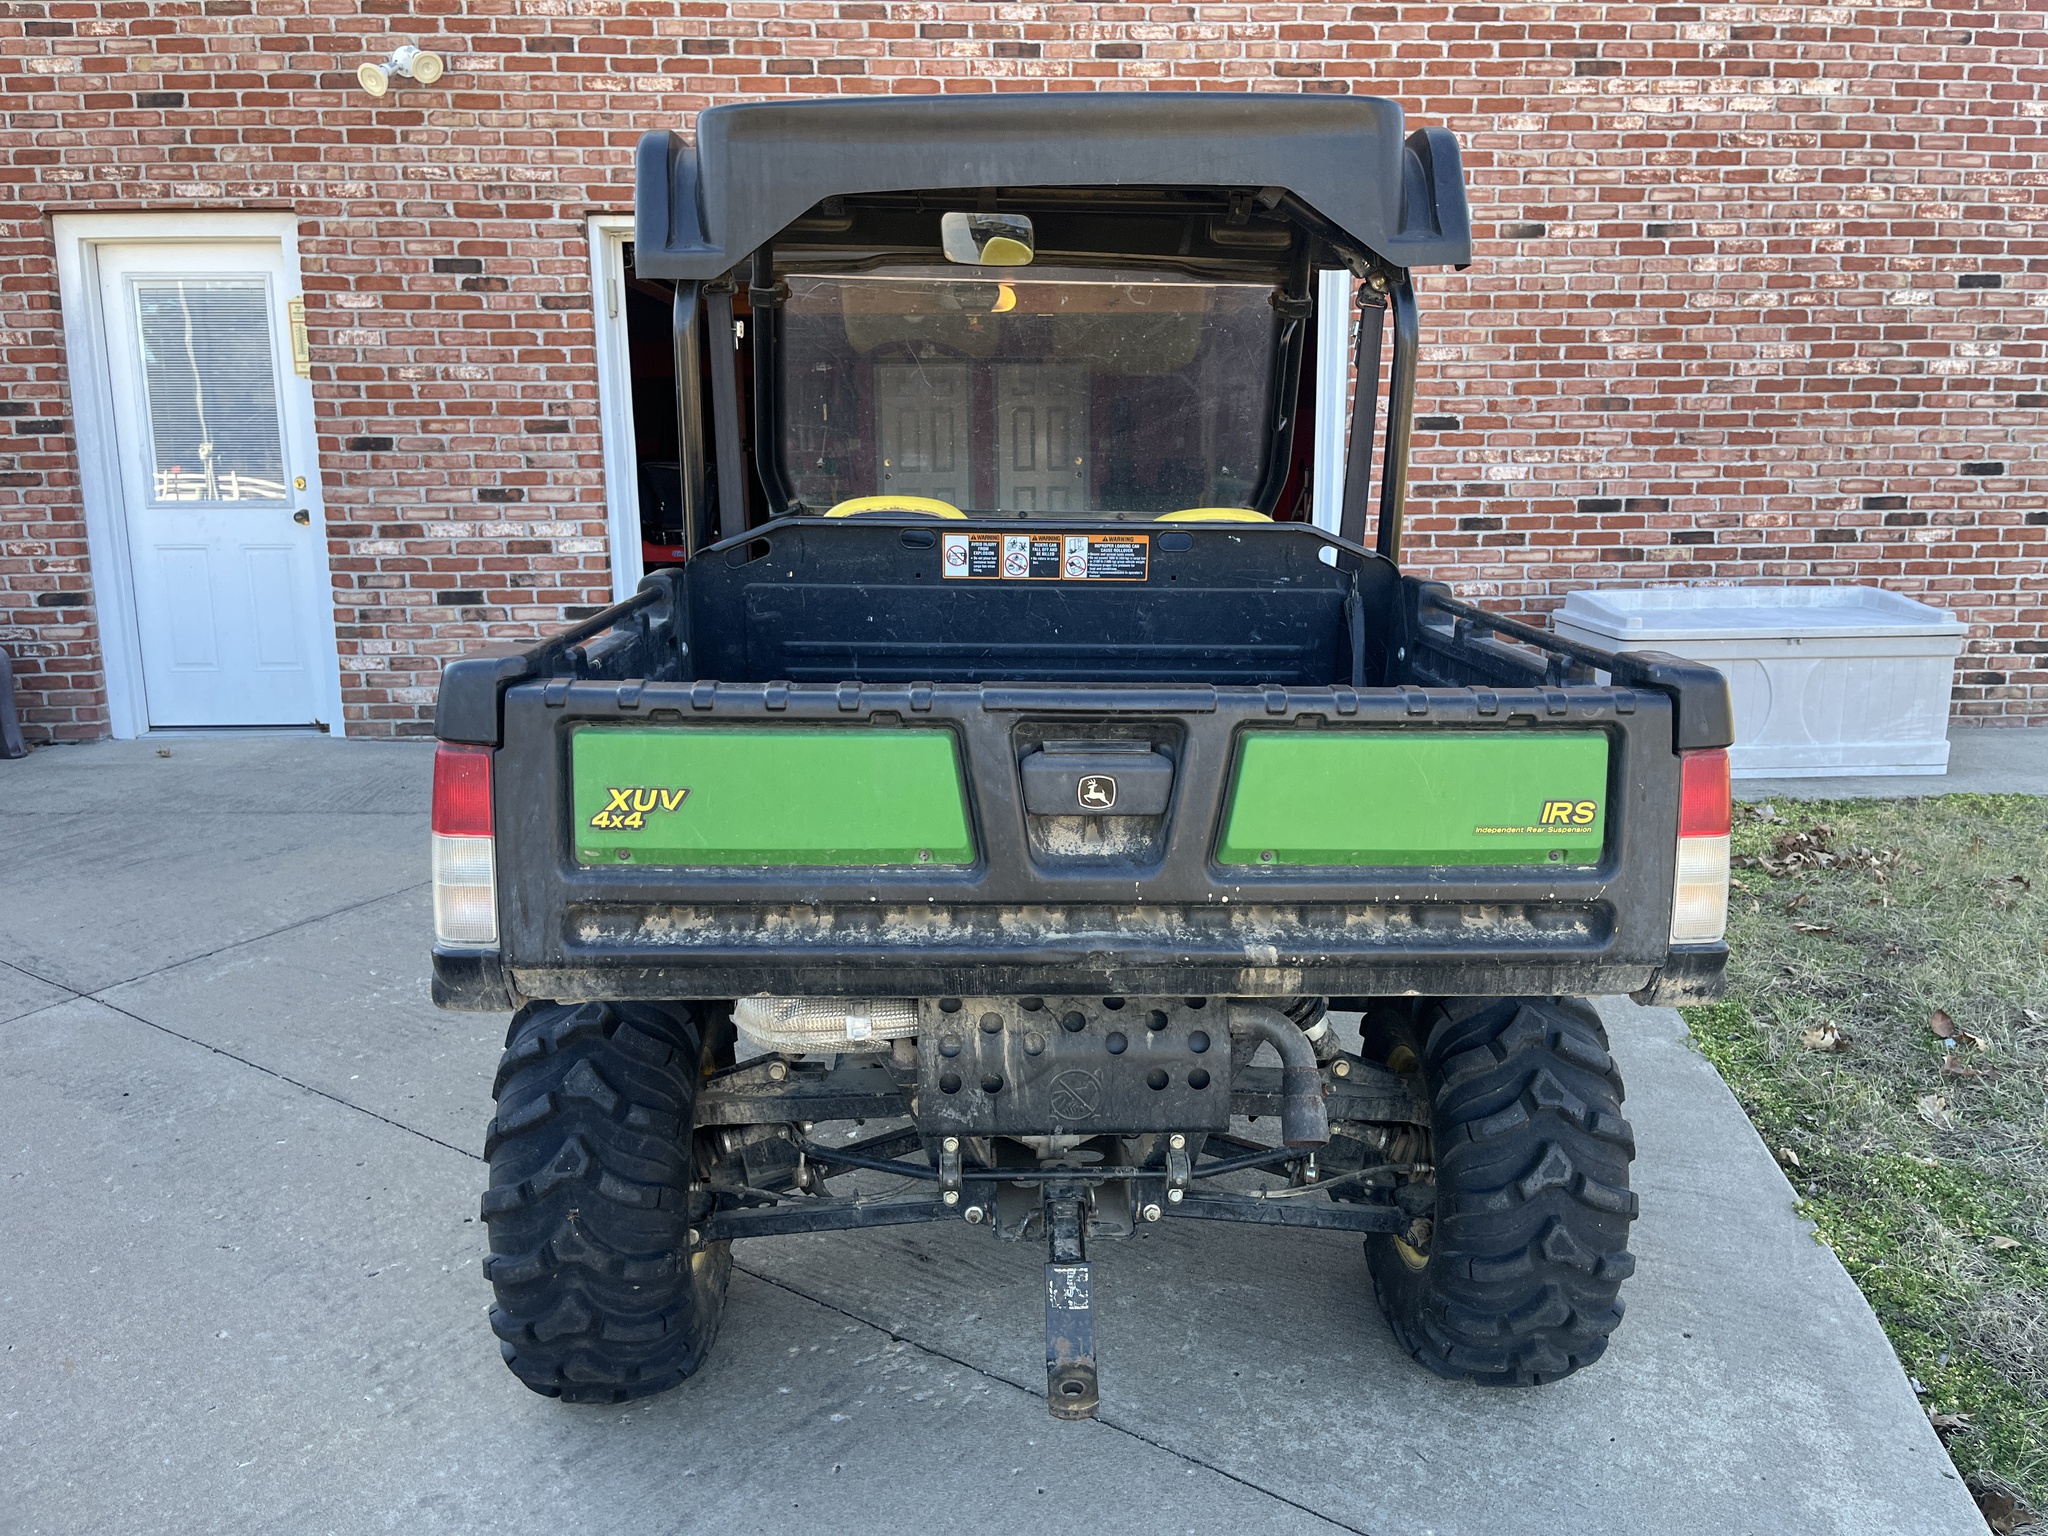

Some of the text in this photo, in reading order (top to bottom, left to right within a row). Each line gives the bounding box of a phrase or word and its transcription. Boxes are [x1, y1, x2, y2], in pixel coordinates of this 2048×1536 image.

[604, 788, 687, 812] XUV
[591, 811, 644, 829] 4x4
[1541, 801, 1596, 824] IRS
